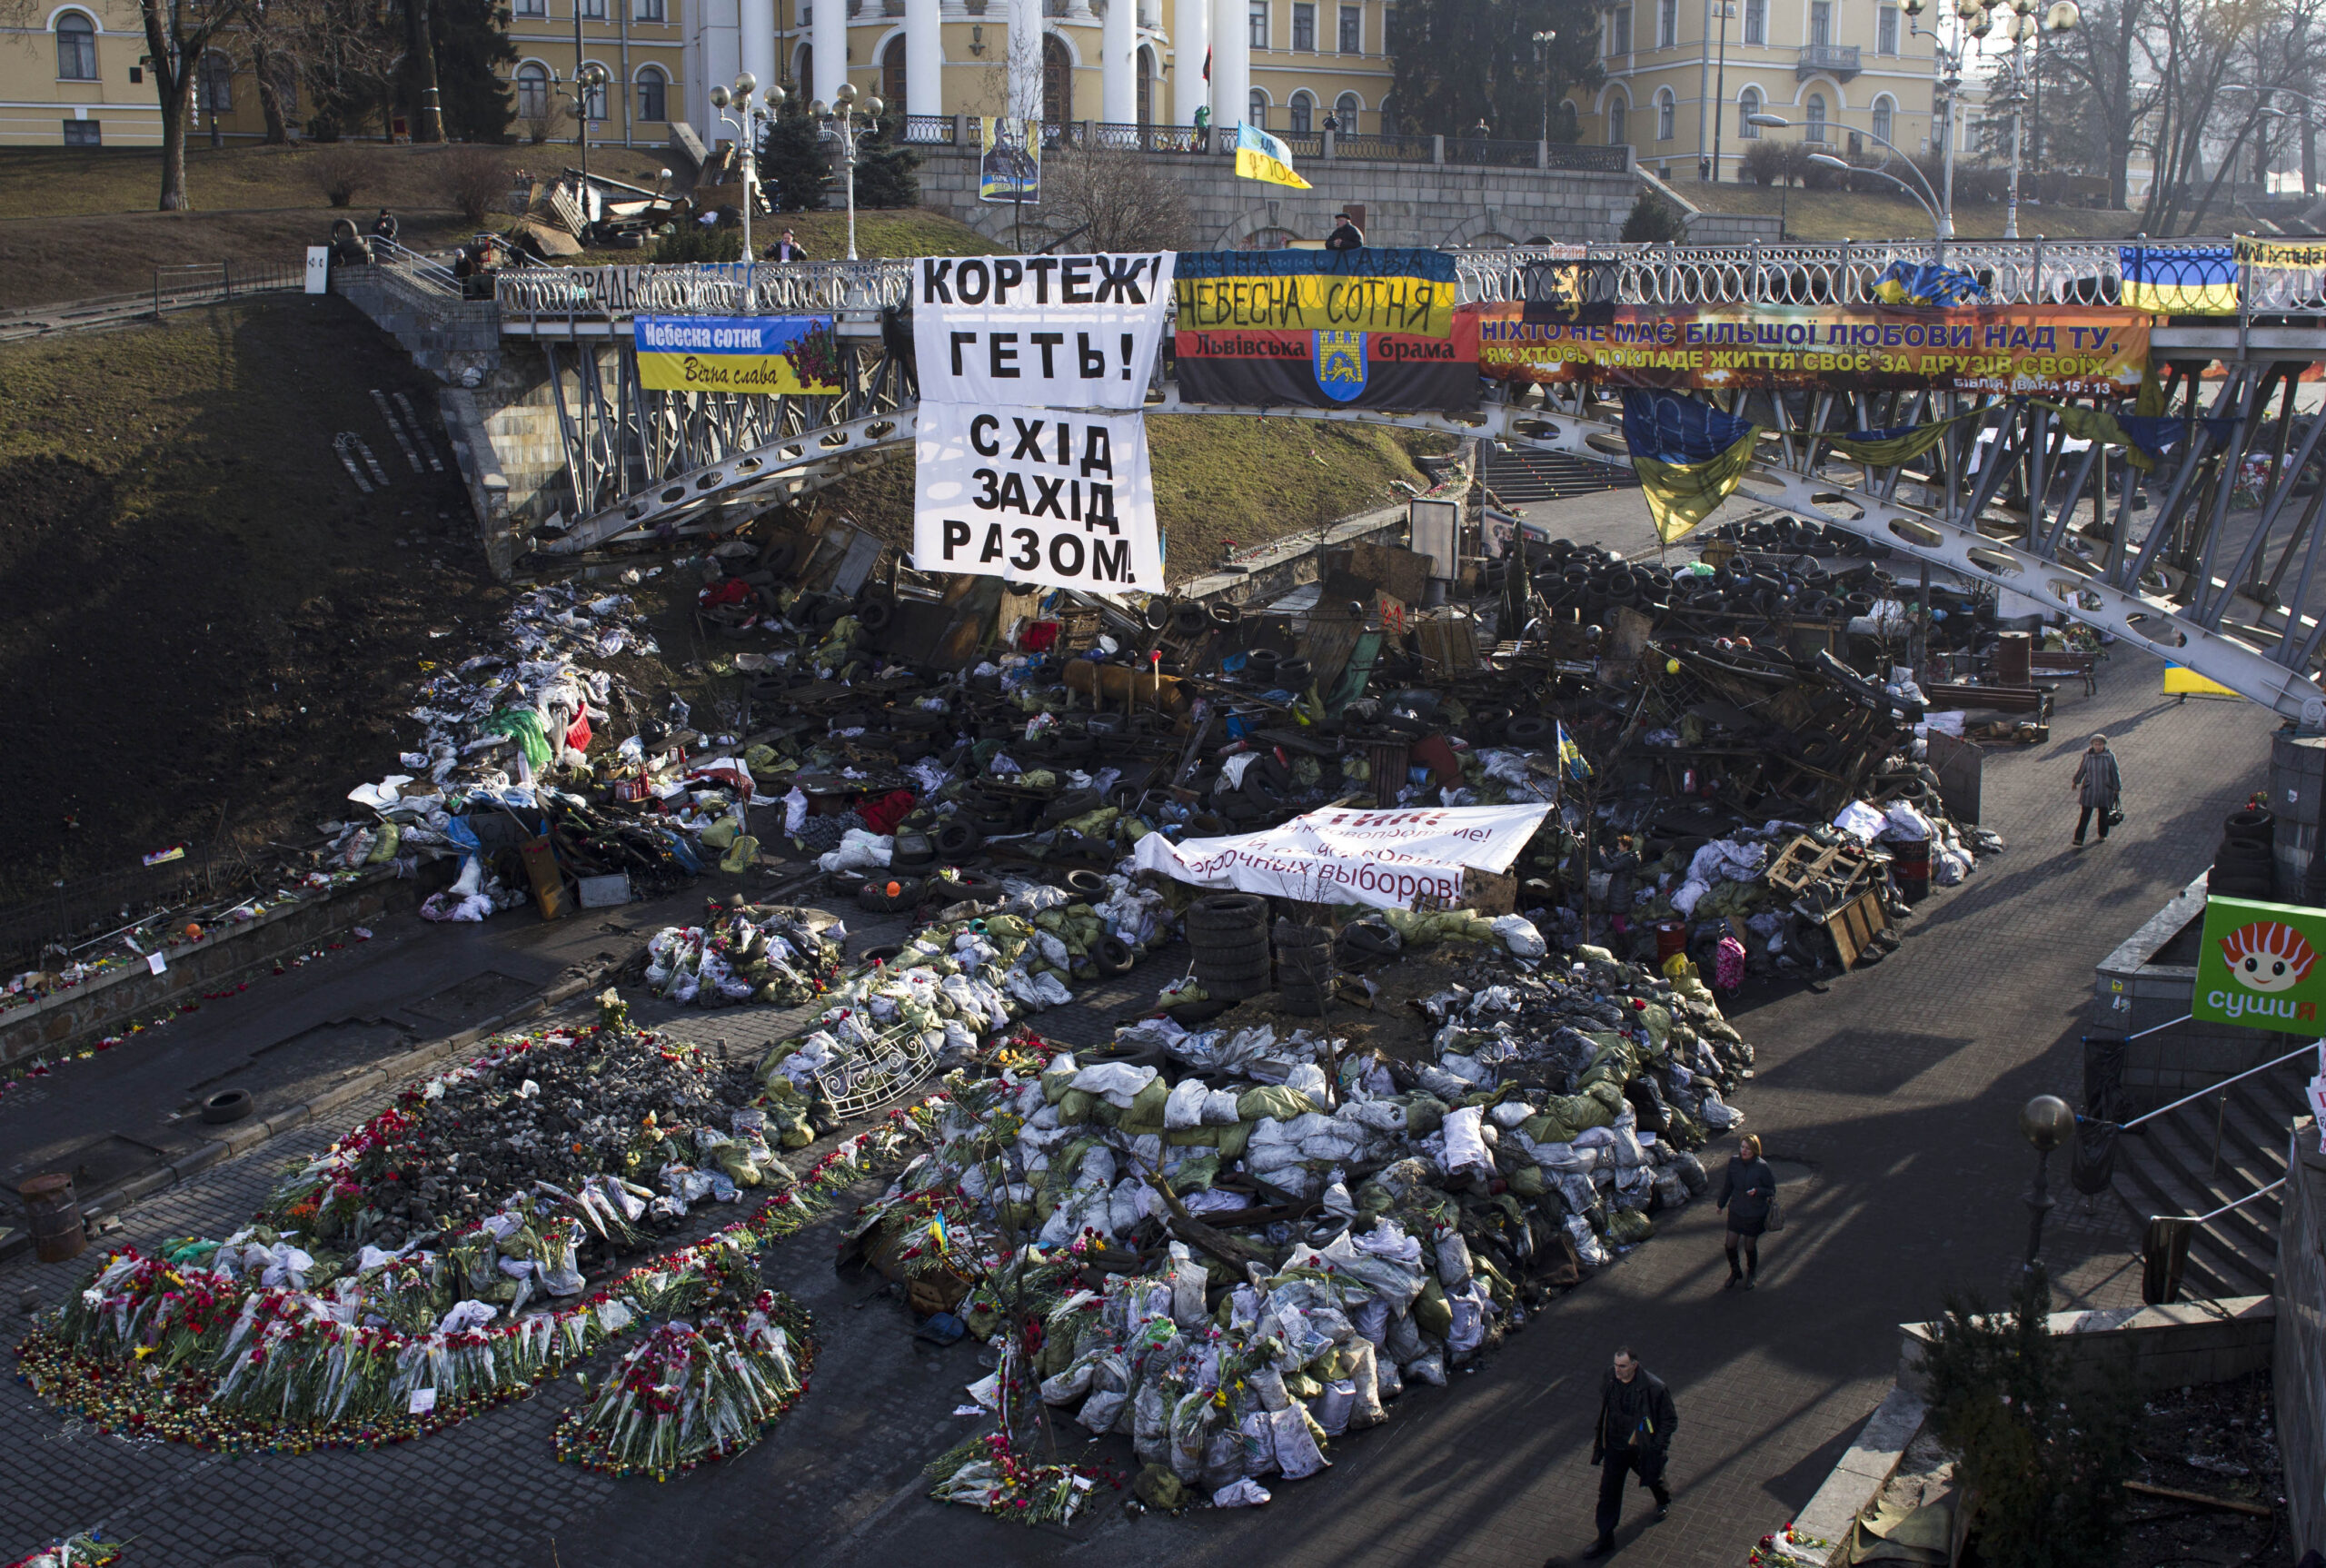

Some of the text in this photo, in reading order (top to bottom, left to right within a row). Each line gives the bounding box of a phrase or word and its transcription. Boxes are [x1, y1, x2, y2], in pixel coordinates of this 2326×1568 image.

[1176, 278, 1433, 332] НЕБЕСНА СОТНЯ
[644, 323, 762, 349] Небесна сотня
[1195, 334, 1456, 362] Львівська брама
[1481, 319, 2120, 355] НІХТО НЕ МАЄ БІЛЬШОЇ ЛЮБОВИ НАД ТУ,
[682, 355, 779, 385] Вічна слава
[949, 332, 1133, 381] ГЕТЬ!
[1486, 346, 2113, 377] ЯК ХТОСЬ ПОКЛАДЕ ЖИТТЯ СВОЄ ЗА ДРУЗІВ СВОЇХ.
[1953, 377, 2008, 392] БІБЛІЯ,
[2011, 378, 2061, 392] ІВАНА
[969, 413, 1113, 480] СХІД
[971, 468, 1120, 534] ЗАХІД
[942, 520, 1137, 584] РАЗОМ!
[1318, 862, 1460, 902] выборов!
